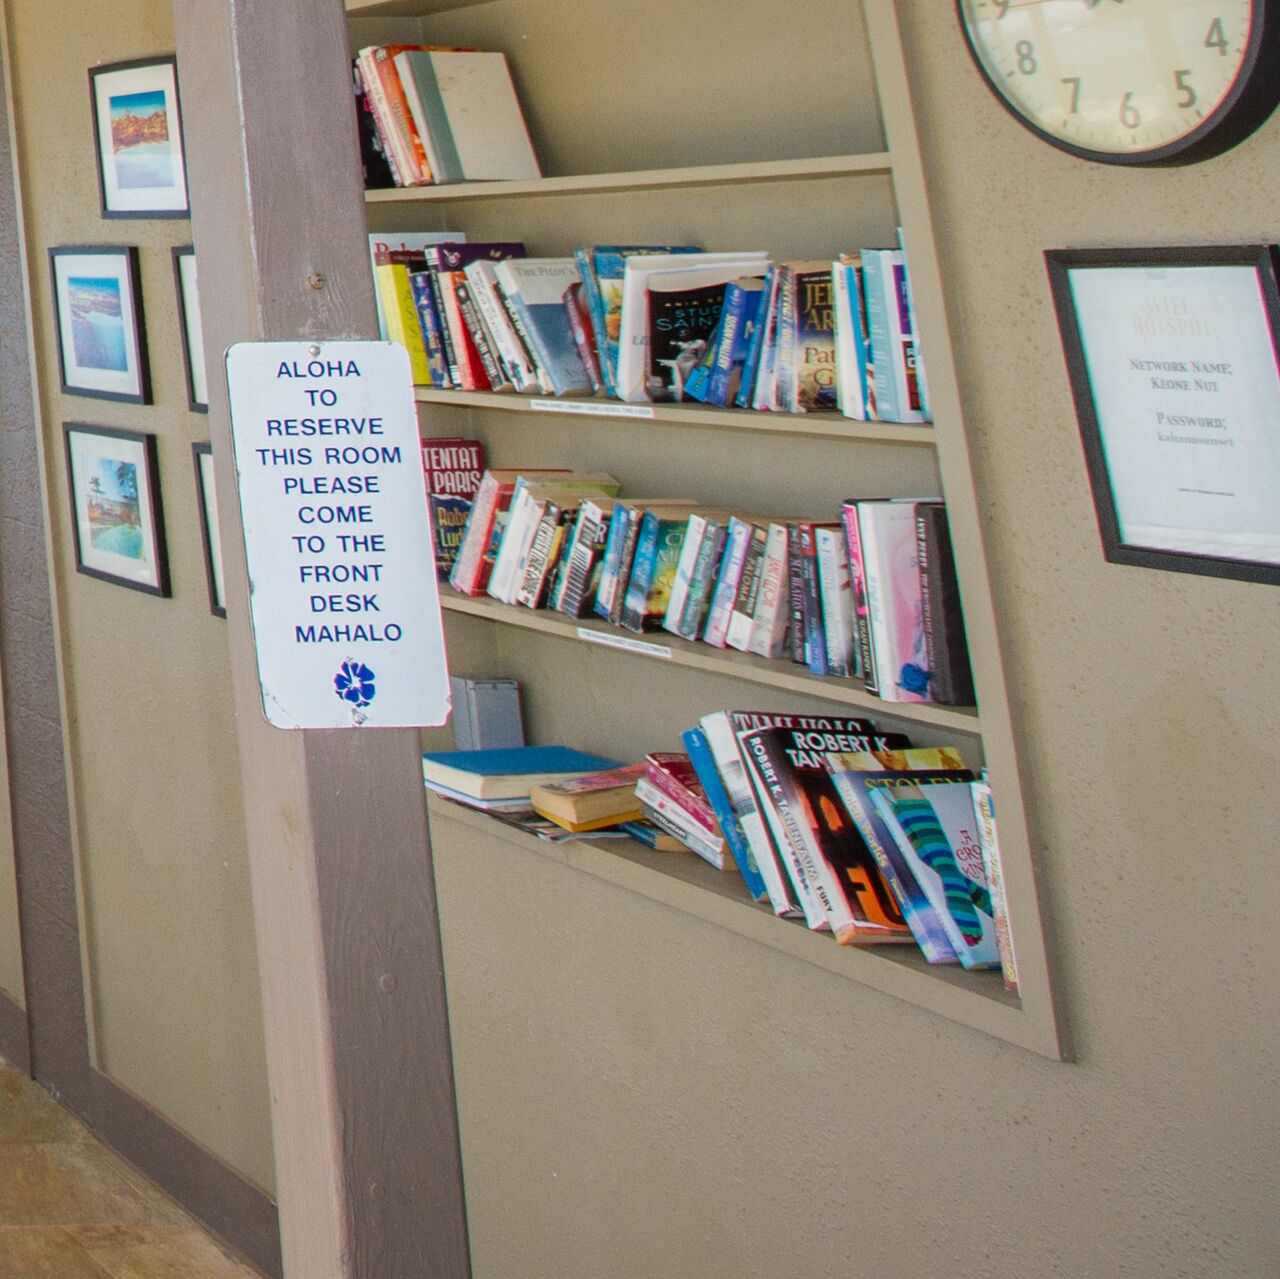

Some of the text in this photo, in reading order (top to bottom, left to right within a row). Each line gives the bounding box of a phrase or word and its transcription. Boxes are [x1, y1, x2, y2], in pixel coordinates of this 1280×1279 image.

[1204, 18, 1228, 56] 4
[1015, 40, 1037, 75] 8
[1061, 77, 1081, 114] 7
[1174, 70, 1196, 108] 5
[1119, 92, 1139, 129] 6
[277, 360, 360, 378] ALOHA
[304, 389, 337, 407] TO
[267, 418, 384, 436] RESERVE
[256, 446, 401, 466] THIS ROOM
[284, 476, 379, 495] PLEASE
[434, 470, 481, 493] PARIS
[298, 506, 373, 524] COME
[292, 534, 385, 554] TO THE
[300, 564, 383, 583] FRONT
[310, 594, 380, 613] DESK
[295, 623, 402, 643] MAHALO
[791, 731, 869, 753] ROBERT
[749, 736, 777, 785] ROBERT
[816, 885, 834, 913] FURY
